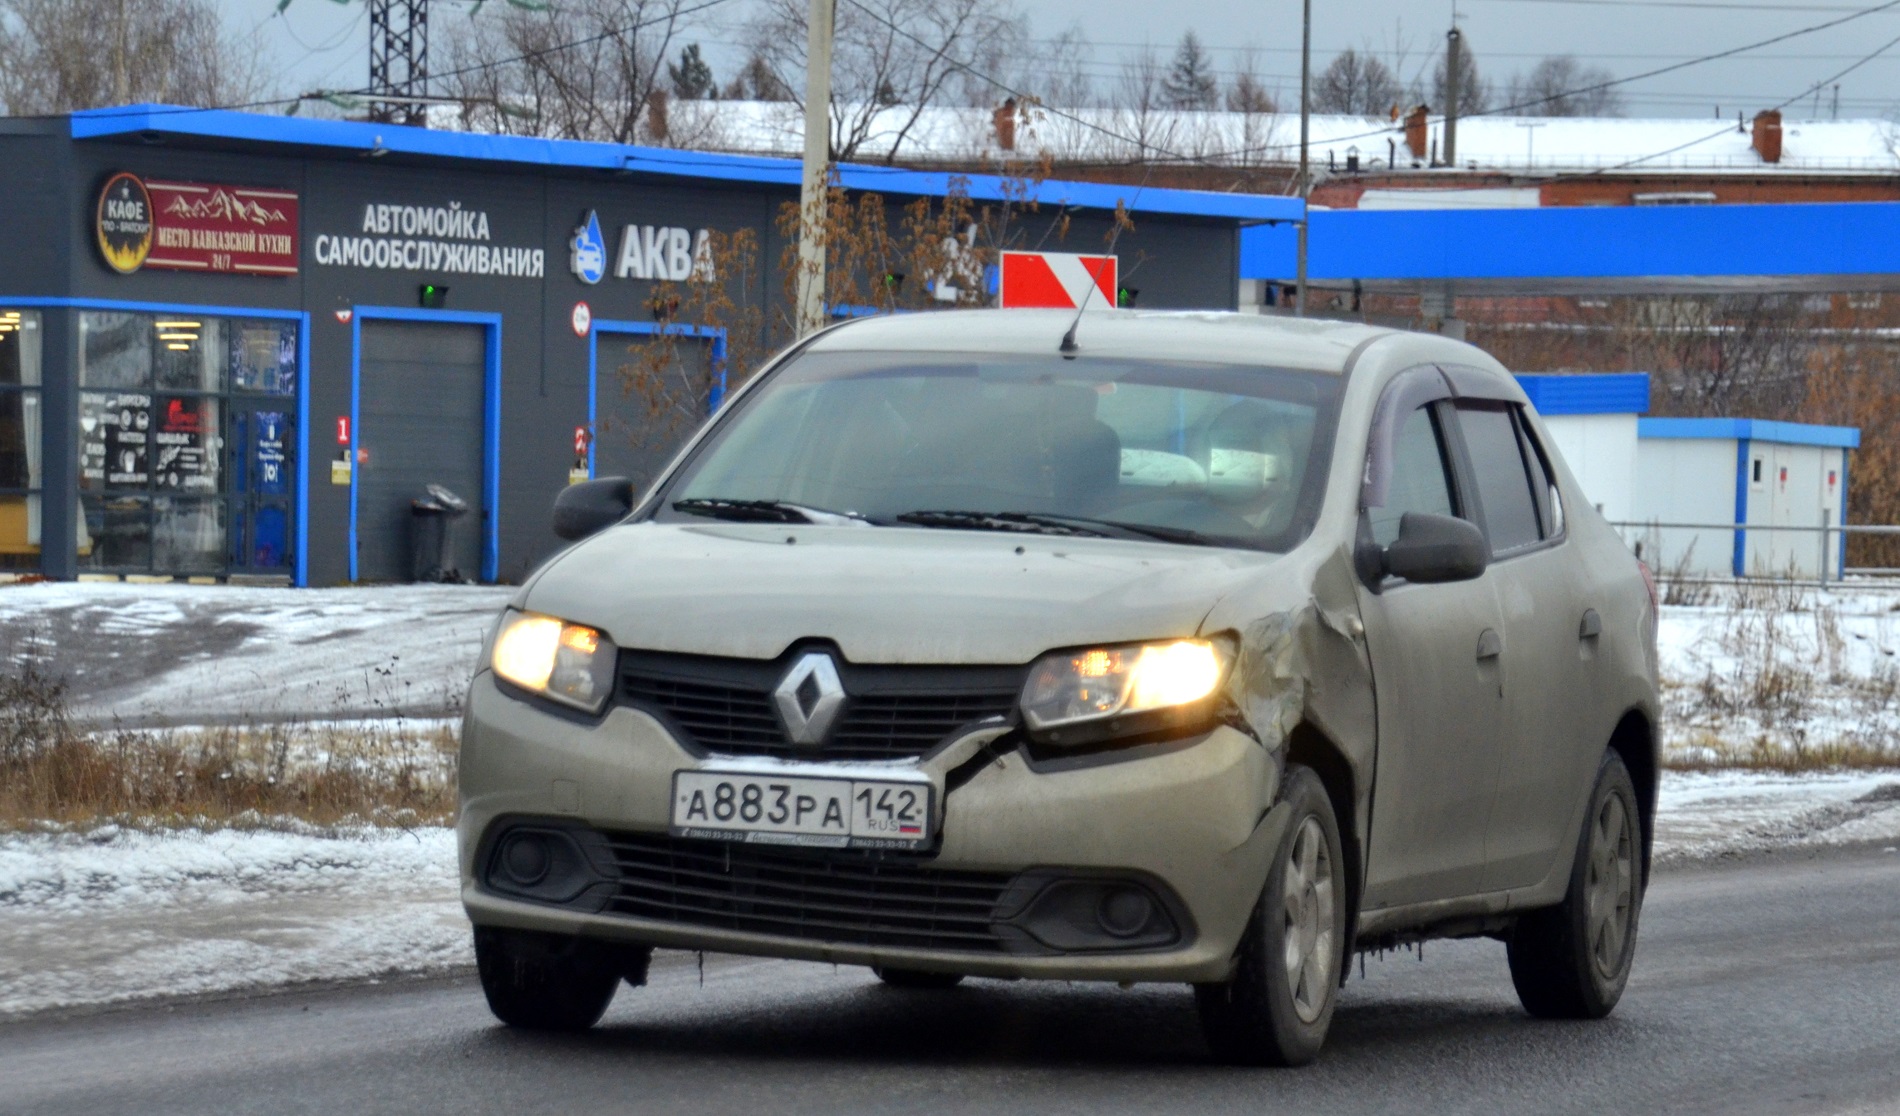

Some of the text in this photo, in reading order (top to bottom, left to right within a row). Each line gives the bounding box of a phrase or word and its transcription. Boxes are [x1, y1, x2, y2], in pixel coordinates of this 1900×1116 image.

[107, 199, 143, 221] КАФЕ
[363, 201, 490, 240] АВТОМОЙКА
[158, 227, 292, 255] МЕСТО КАВКАЗСКОЙ КУХНИ
[614, 223, 716, 283] АКВА
[212, 254, 231, 270] 24/7
[315, 234, 544, 278] САМООБСЛУЖИВАНИЯ
[339, 419, 348, 441] 1
[856, 788, 918, 821] 142
[868, 818, 898, 832] RUS
